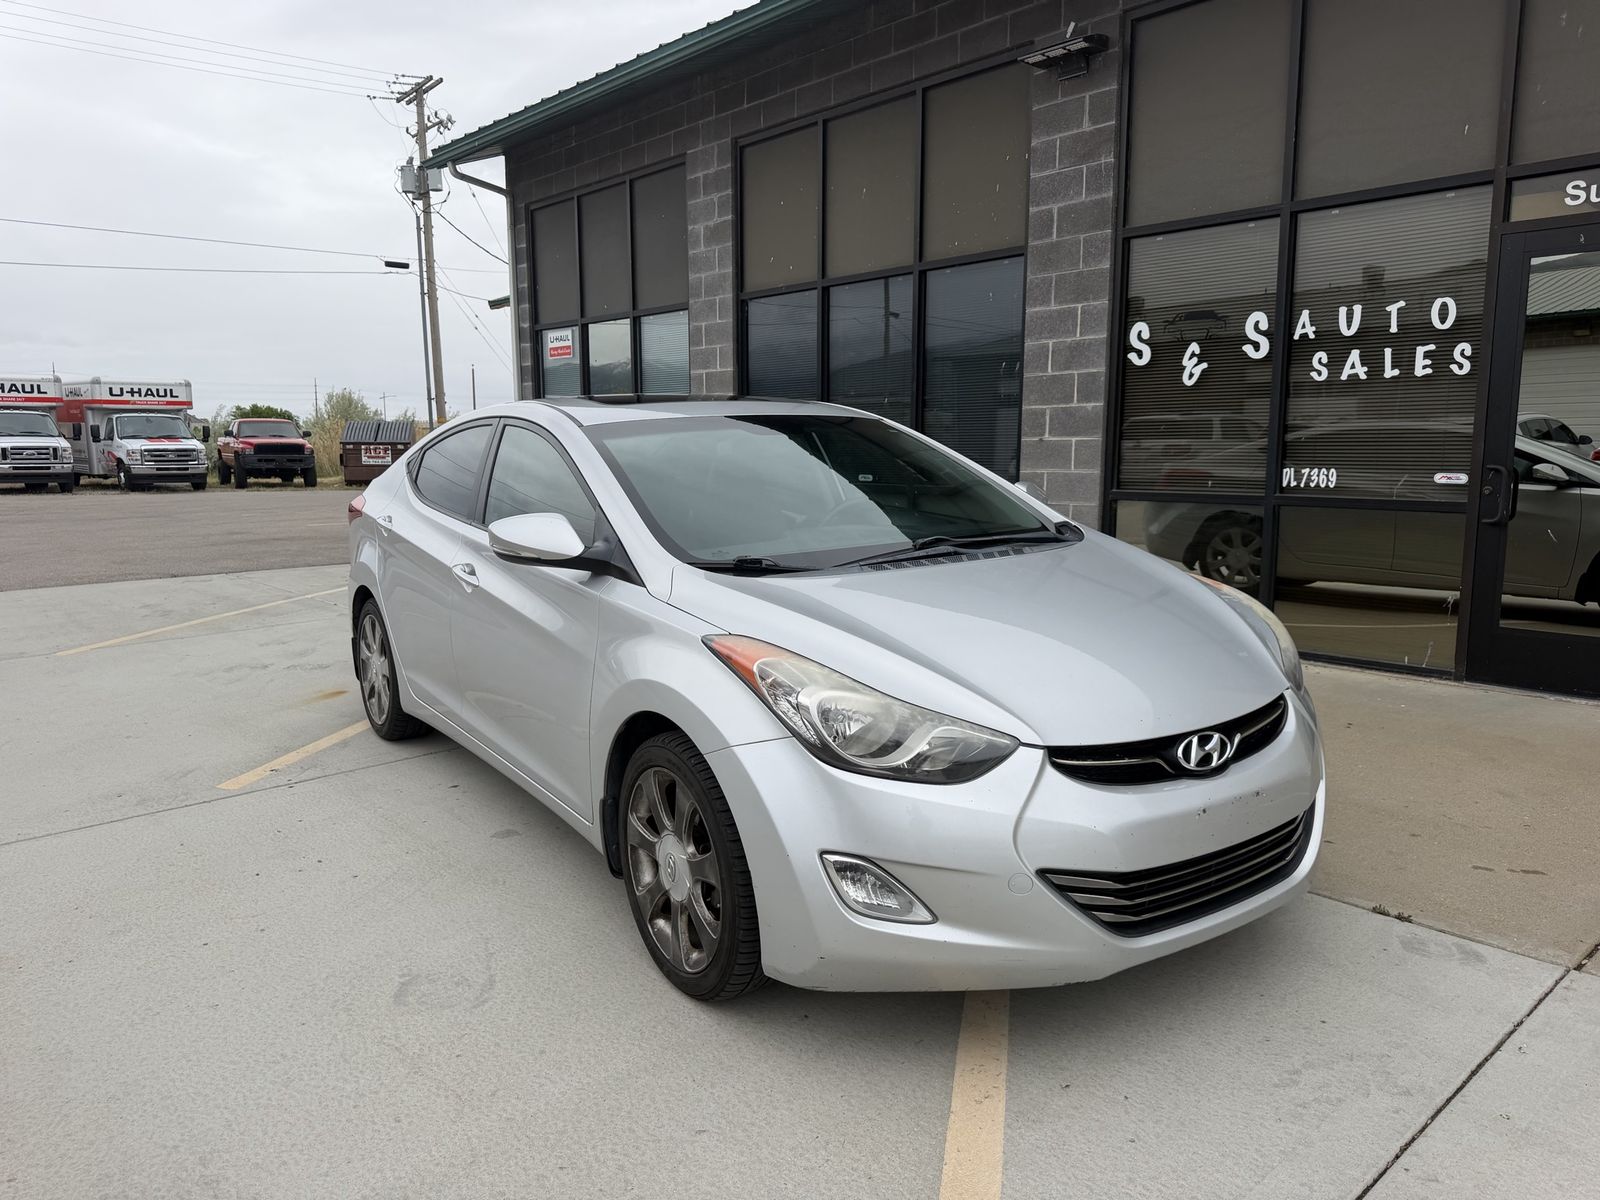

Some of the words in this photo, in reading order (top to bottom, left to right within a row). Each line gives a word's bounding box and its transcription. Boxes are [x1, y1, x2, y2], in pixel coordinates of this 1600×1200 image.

[1182, 342, 1208, 386] &
[1294, 297, 1457, 340] AUTO
[1310, 343, 1472, 382] SALES
[1282, 467, 1297, 488] DL
[1300, 467, 1337, 488] 7369
